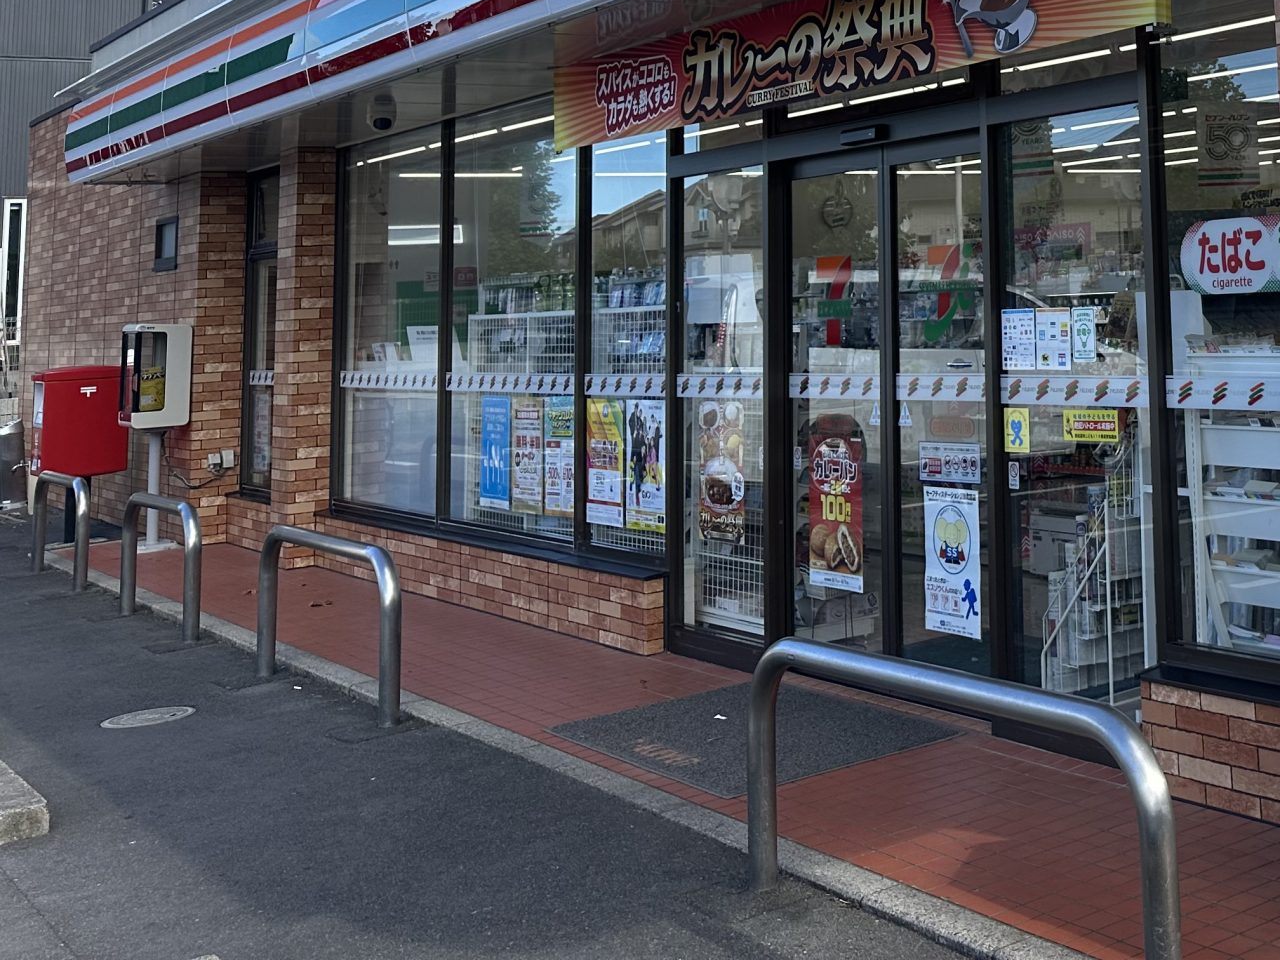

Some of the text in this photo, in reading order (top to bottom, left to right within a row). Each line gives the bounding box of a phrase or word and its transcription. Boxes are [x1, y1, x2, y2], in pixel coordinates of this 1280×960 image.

[599, 63, 670, 97] スパイスがココロも
[747, 82, 814, 105] CURRY FESTIVAL
[1198, 227, 1265, 275] たばこ
[1212, 275, 1253, 290] cigarette
[815, 459, 857, 482] カレーパン
[947, 548, 958, 557] SS
